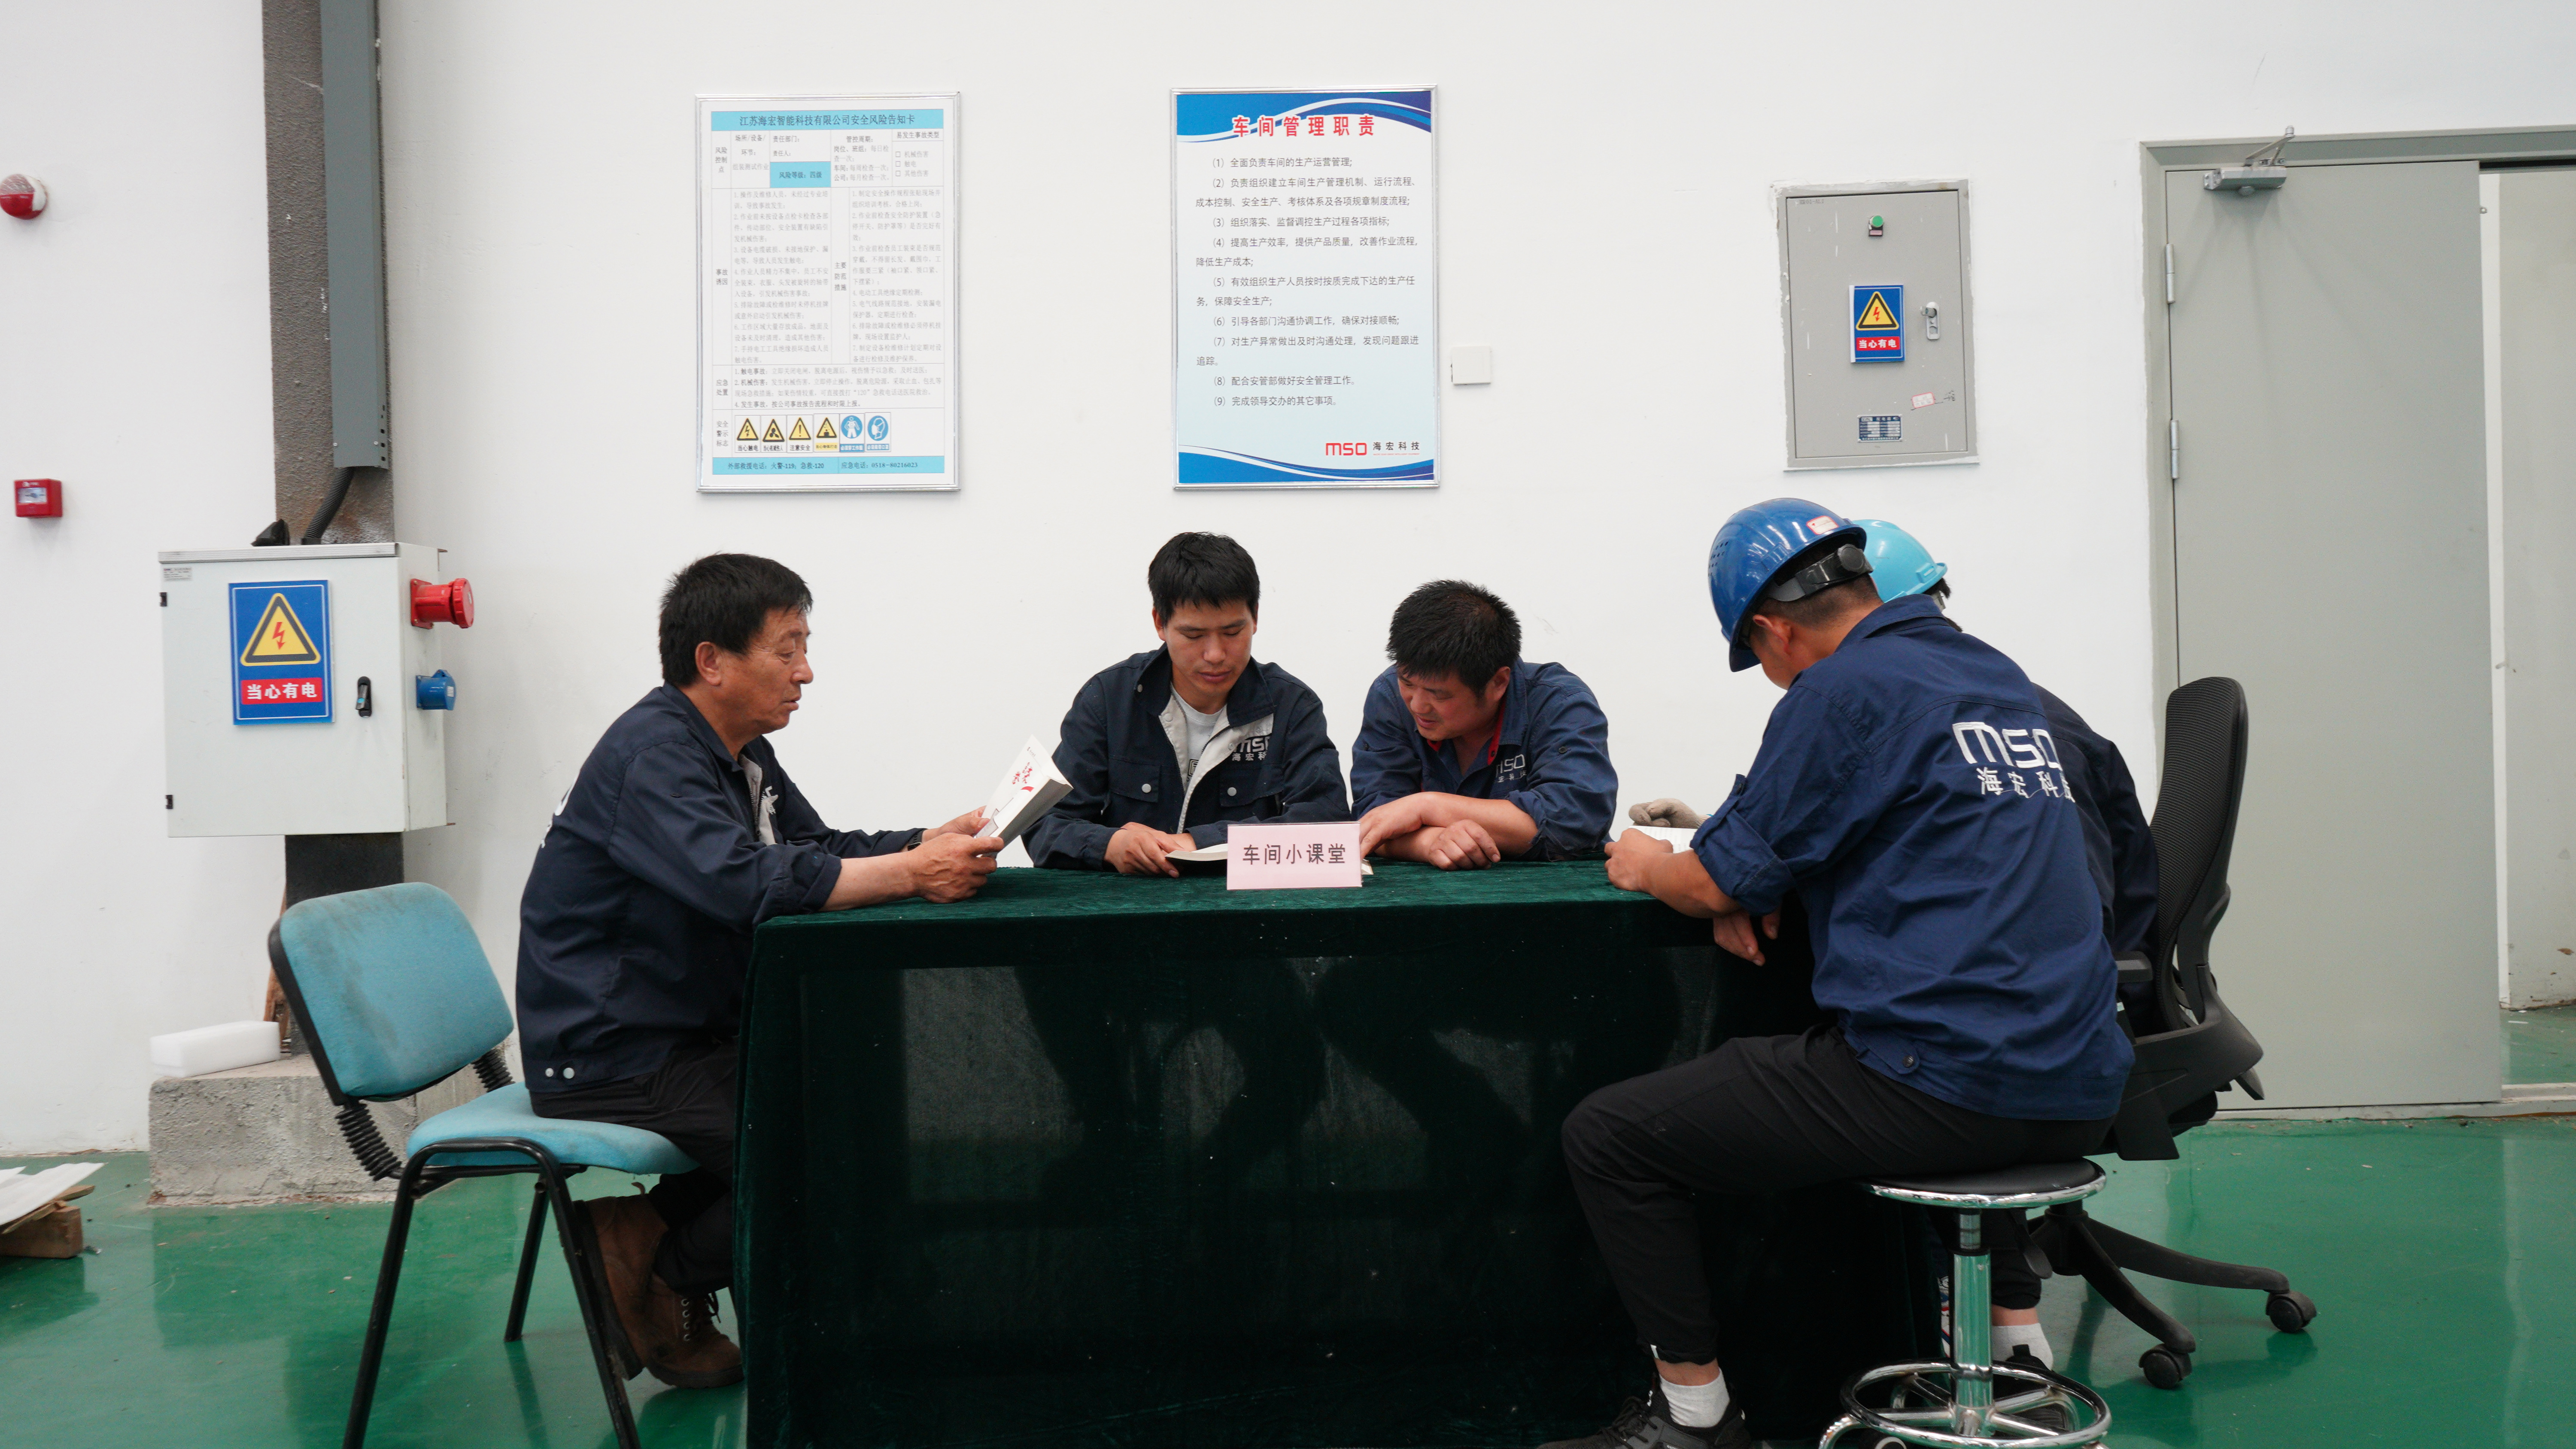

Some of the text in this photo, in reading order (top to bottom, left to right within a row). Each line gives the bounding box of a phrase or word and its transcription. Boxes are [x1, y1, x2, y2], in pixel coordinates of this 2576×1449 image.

[740, 114, 915, 126] 江苏海宏智能科技有限公司安全风险告知卡
[1233, 116, 1374, 136] 车间管理职责
[1859, 339, 1897, 349] 当心有电
[1373, 442, 1420, 451] 海宏科技
[247, 682, 317, 700] 当心有电
[1243, 843, 1346, 864] 车间小课堂
